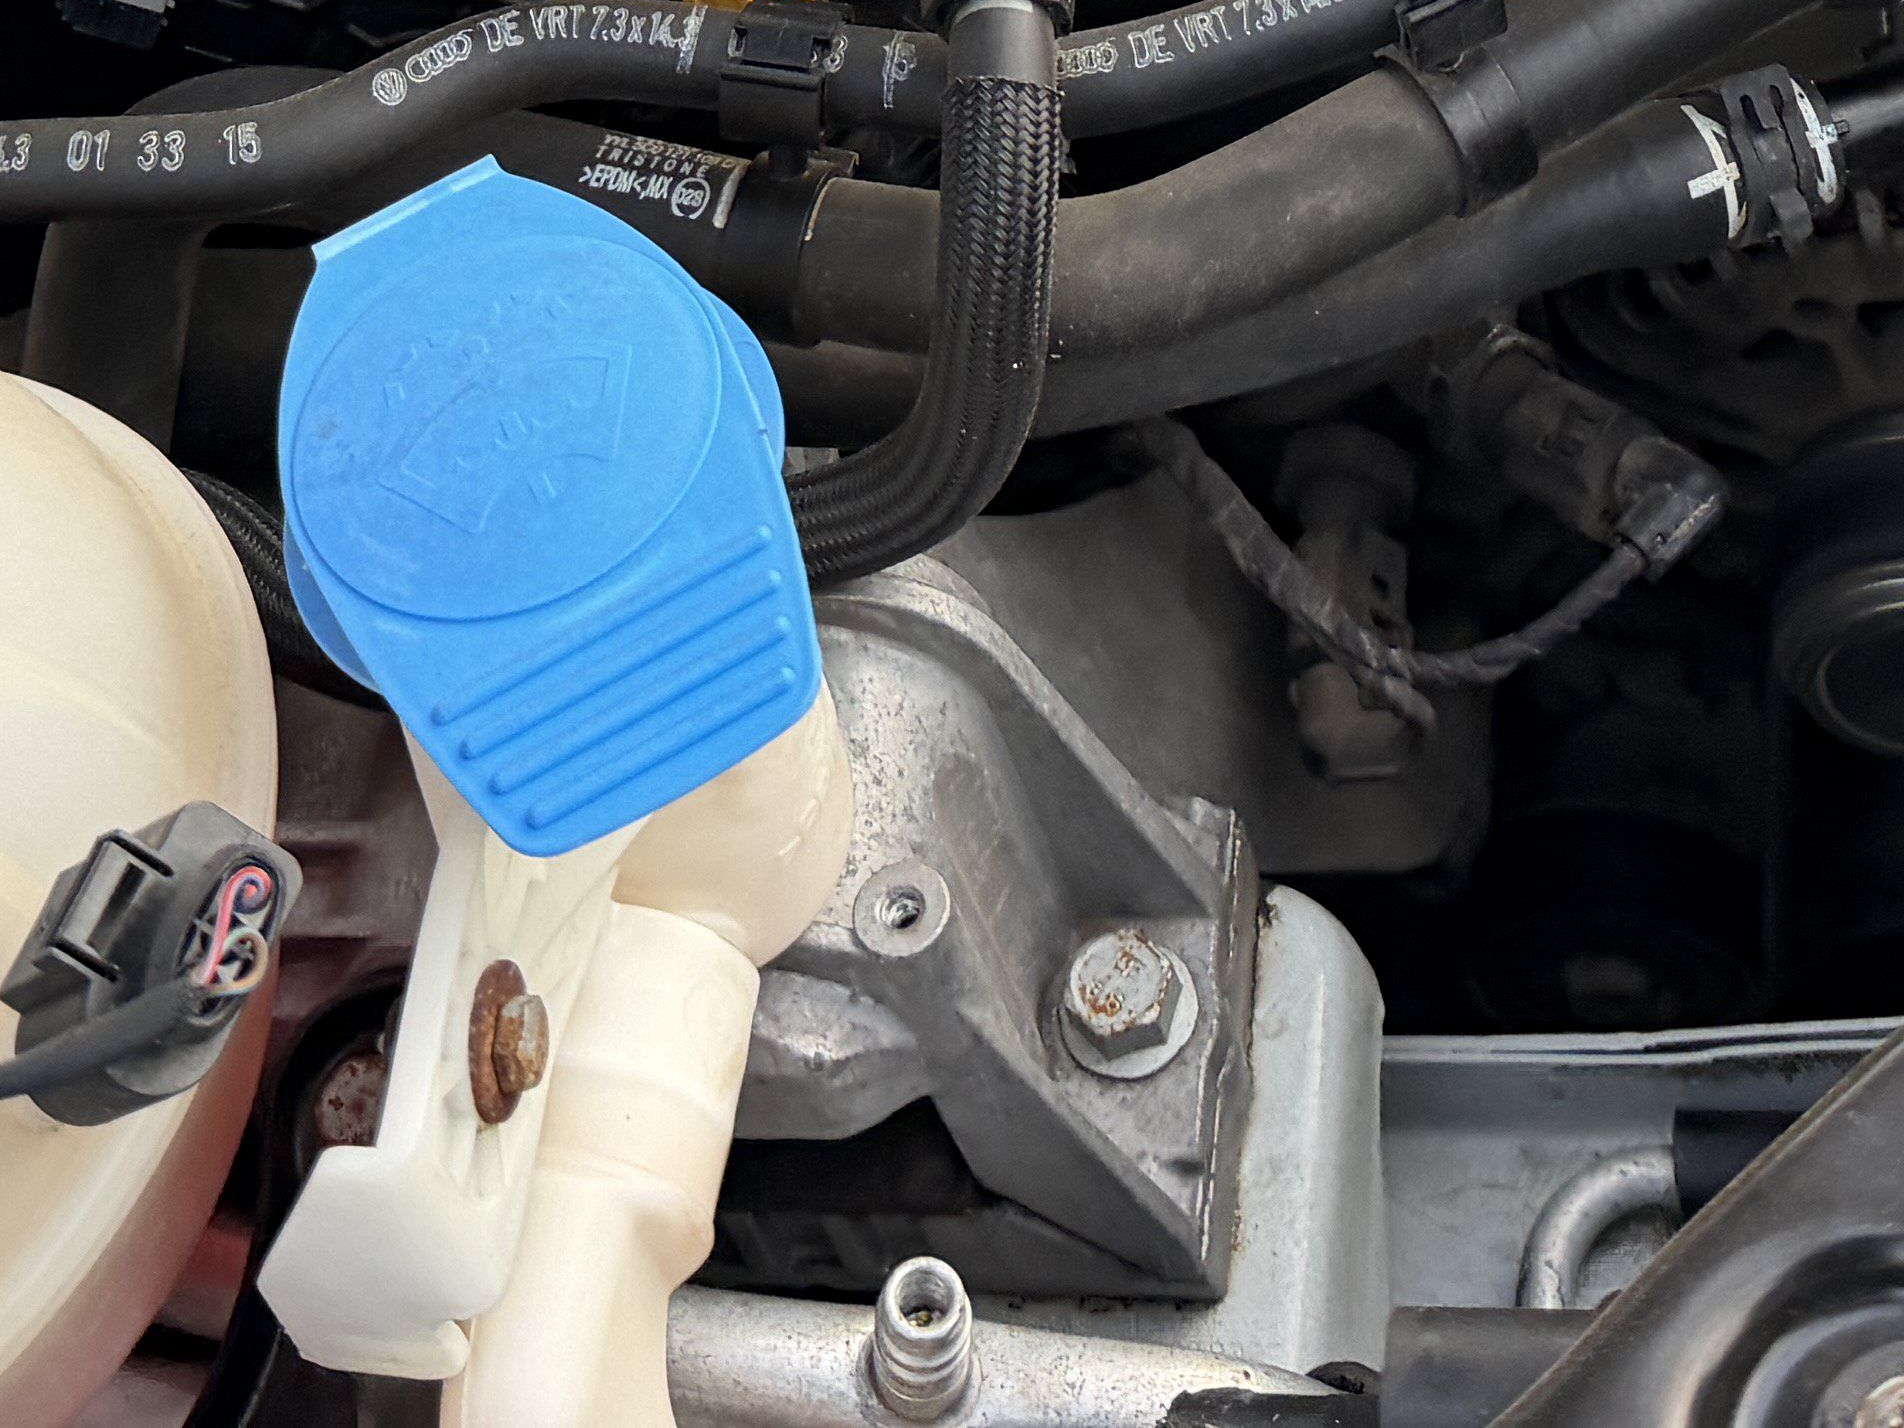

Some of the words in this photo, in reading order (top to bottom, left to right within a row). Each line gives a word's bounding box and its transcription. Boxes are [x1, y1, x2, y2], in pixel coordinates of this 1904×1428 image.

[483, 10, 524, 53] DE
[529, 4, 586, 40] VRT
[1128, 24, 1175, 70] DE
[1175, 3, 1232, 55] VRT
[67, 129, 109, 172] 01
[136, 129, 187, 173] 33
[223, 120, 263, 165] 15
[595, 144, 712, 179] TRISTONE
